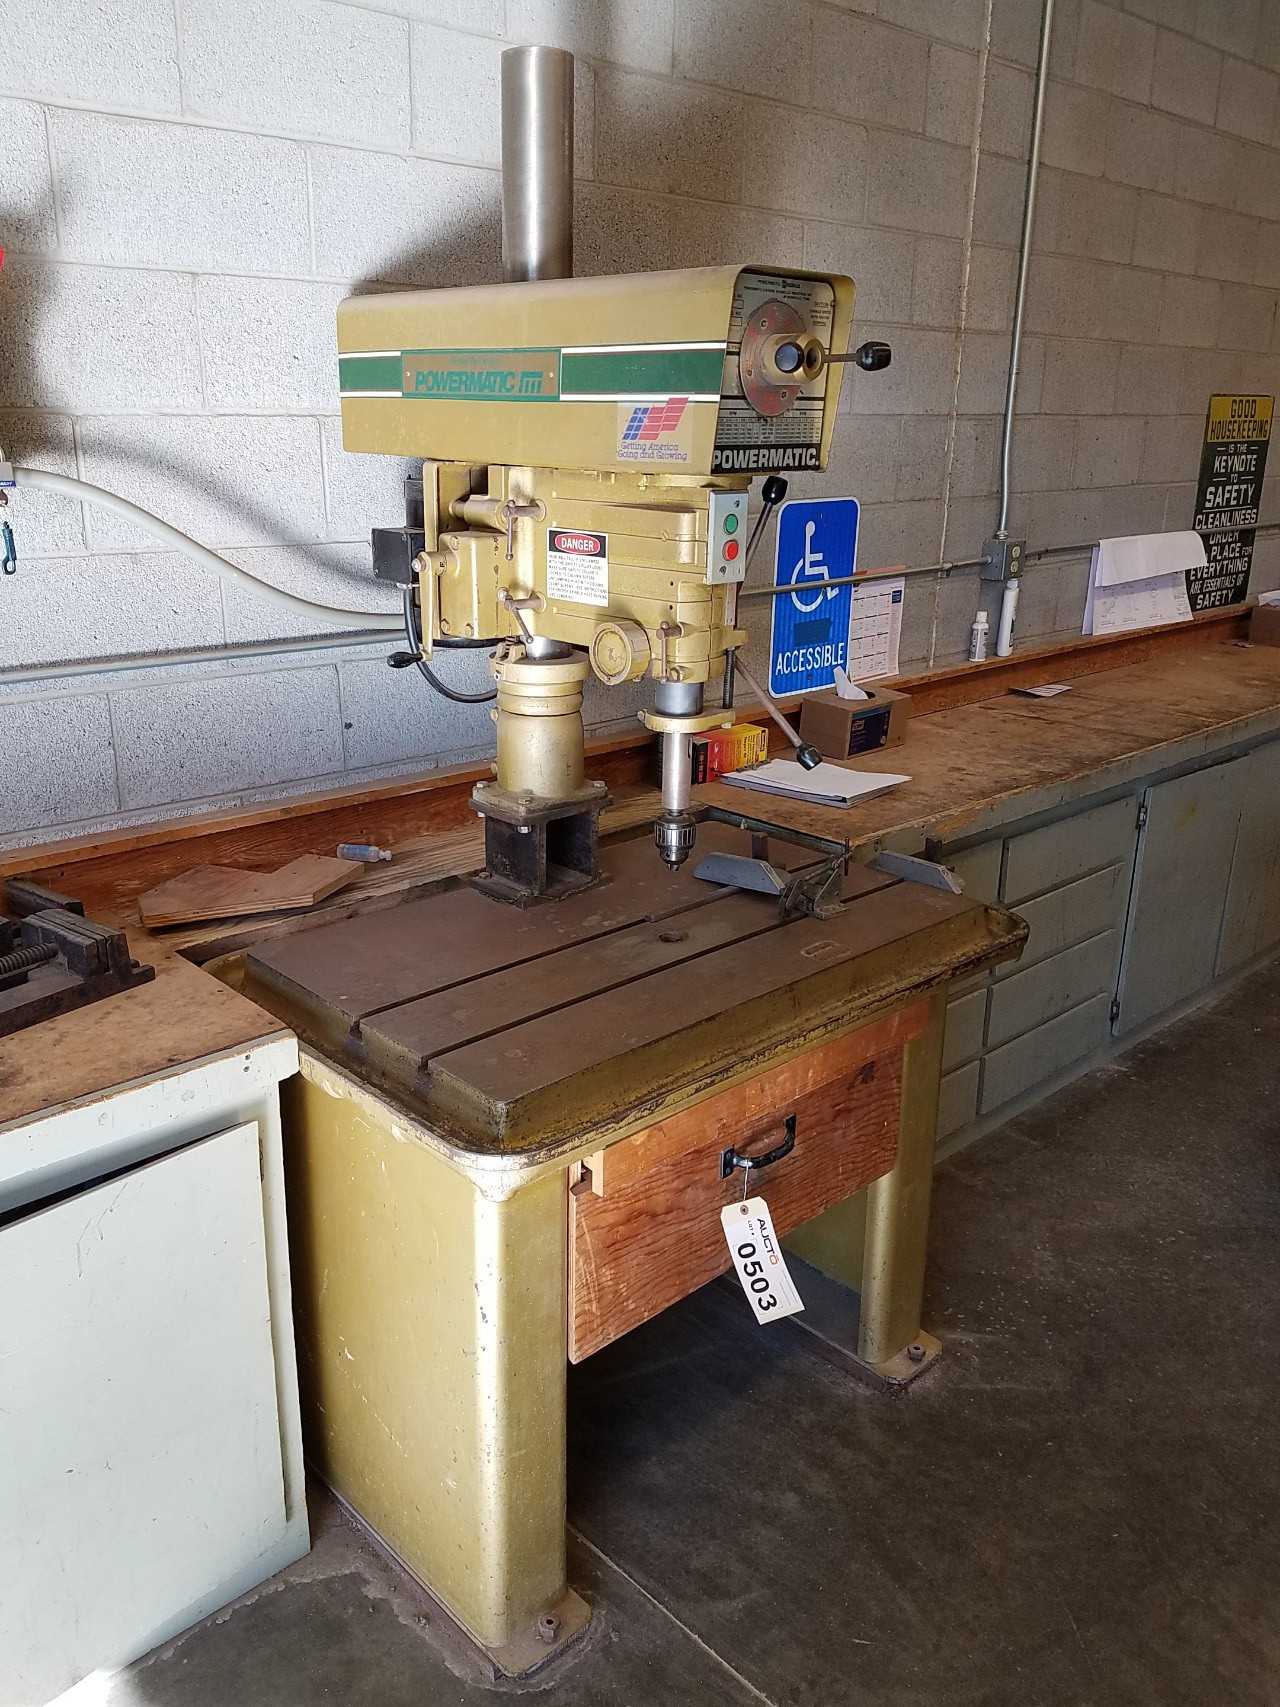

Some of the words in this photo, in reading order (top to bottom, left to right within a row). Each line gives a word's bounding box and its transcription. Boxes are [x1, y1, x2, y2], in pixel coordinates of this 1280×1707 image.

[415, 370, 515, 393] POWERMATIC
[1231, 399, 1256, 418] GOOD
[1210, 419, 1268, 440] HOUSEKEEPING
[1228, 444, 1235, 453] IS
[1237, 443, 1247, 453] THE
[1213, 455, 1257, 472] KEYNOTE
[1231, 473, 1239, 483] TO
[1205, 483, 1255, 507] SAFETY
[1195, 509, 1257, 529] CLEANLINESS
[561, 537, 594, 552] DANGER
[1211, 543, 1241, 560] PLACE
[1190, 557, 1248, 580] EVERYTHING
[1190, 581, 1202, 594] ARE
[1203, 574, 1236, 592] ESSENTIALS
[1196, 588, 1234, 609] SAFETY
[775, 642, 845, 676] ACCESSIBLE
[737, 1242, 778, 1311] 0503
